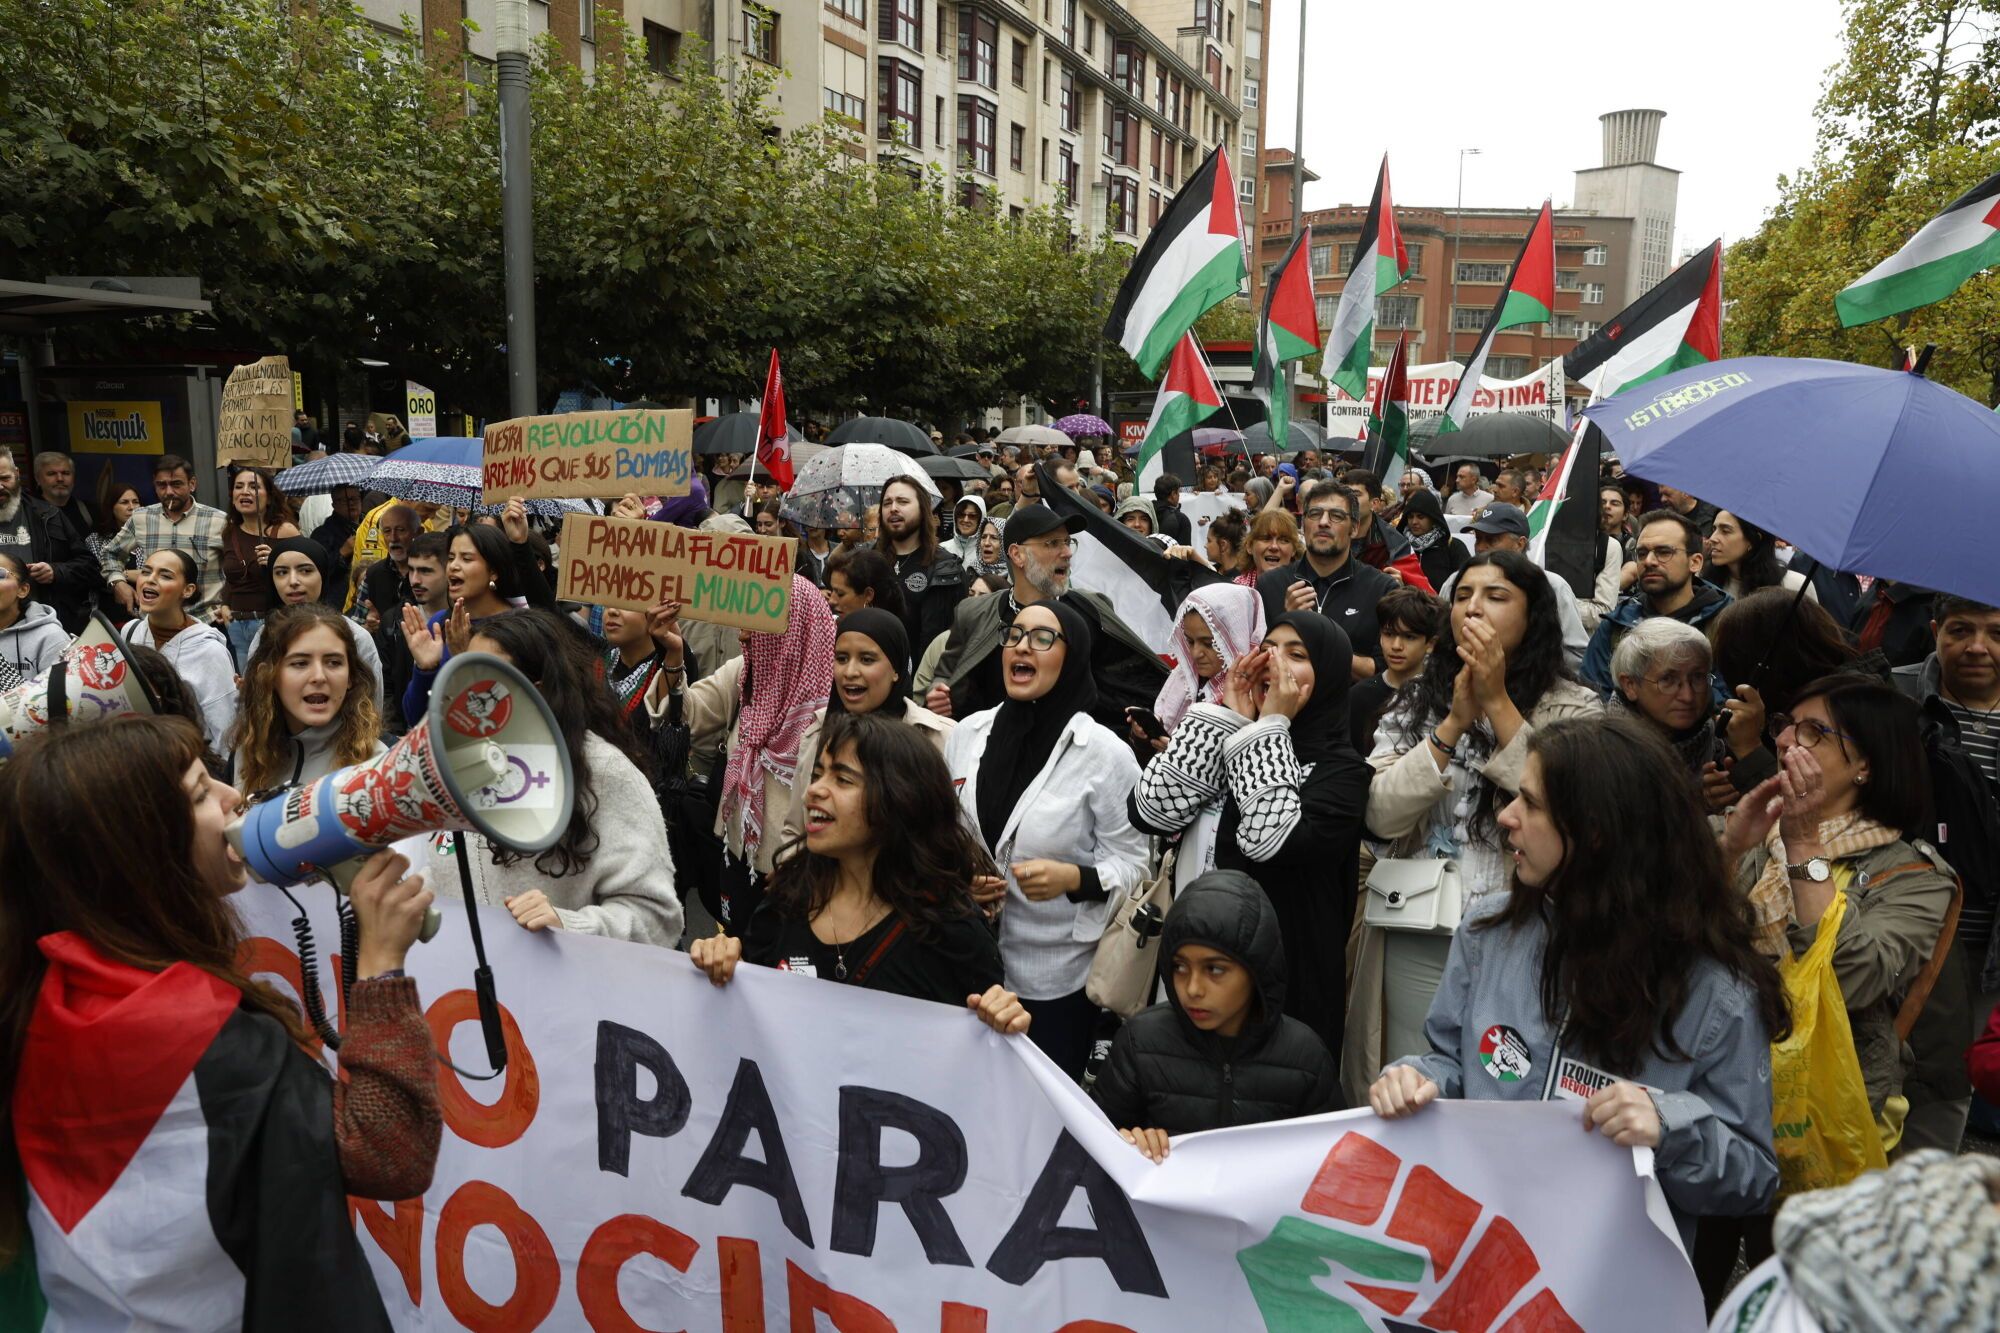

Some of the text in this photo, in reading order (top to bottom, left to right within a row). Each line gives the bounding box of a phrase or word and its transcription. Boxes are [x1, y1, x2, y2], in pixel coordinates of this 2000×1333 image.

[261, 414, 277, 430] MI
[409, 398, 434, 414] ORO
[1331, 406, 1361, 416] CONTRA
[1363, 407, 1370, 417] EL
[83, 411, 148, 447] Nesquik
[219, 432, 270, 449] SILENCIO
[483, 410, 666, 457] NUESTRA REVOLUCIÓN
[1126, 425, 1147, 437] KIW
[483, 462, 510, 491] ARDE
[540, 456, 581, 482] QUE
[583, 451, 612, 480] SUS
[616, 447, 690, 485] BOMBAS
[587, 520, 789, 581] PARAN LA FLOTILLA
[570, 559, 786, 619] PARAMOS EL MUNDO
[597, 1020, 1170, 1299] PARA
